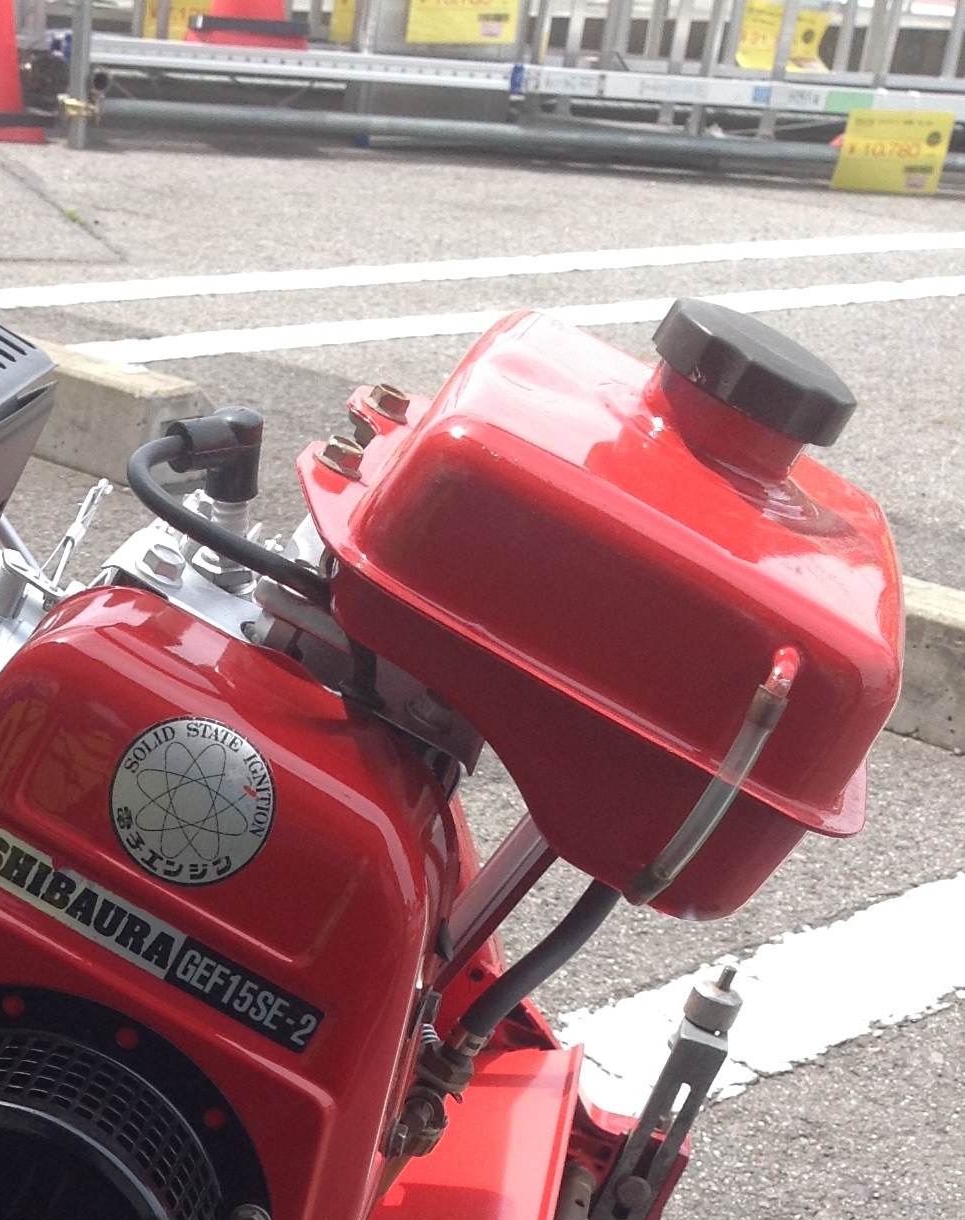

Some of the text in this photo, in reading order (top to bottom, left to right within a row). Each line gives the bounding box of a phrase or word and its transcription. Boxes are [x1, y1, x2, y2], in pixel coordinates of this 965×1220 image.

[124, 722, 272, 838] SOLID STATE IGNITION
[116, 805, 233, 881] 電子エンジン
[175, 949, 318, 1047] GEF15SE-2
